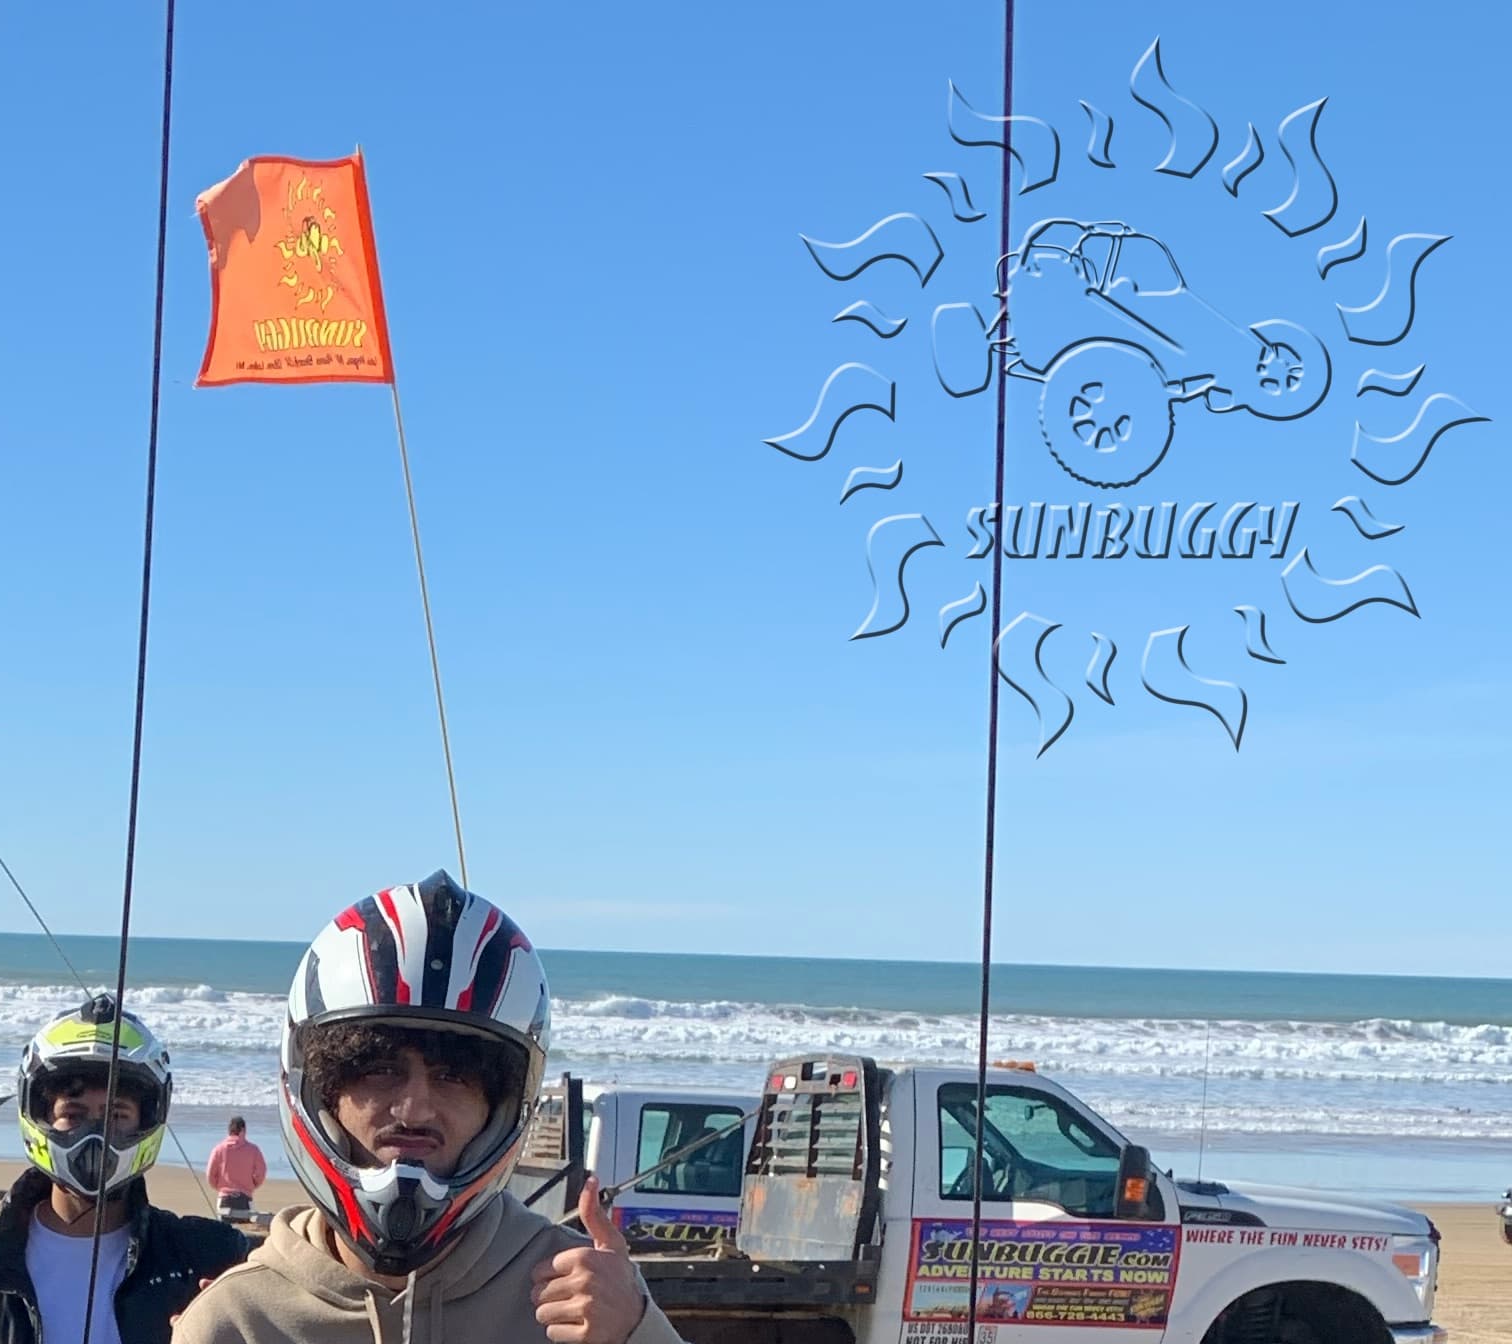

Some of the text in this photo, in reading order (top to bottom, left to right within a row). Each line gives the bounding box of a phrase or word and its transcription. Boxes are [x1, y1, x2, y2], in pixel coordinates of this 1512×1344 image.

[1185, 1229, 1388, 1251] WHERE THE FUN NEVER SETS!
[1039, 1267, 1114, 1282] STARTS
[1119, 1269, 1170, 1285] NOW!
